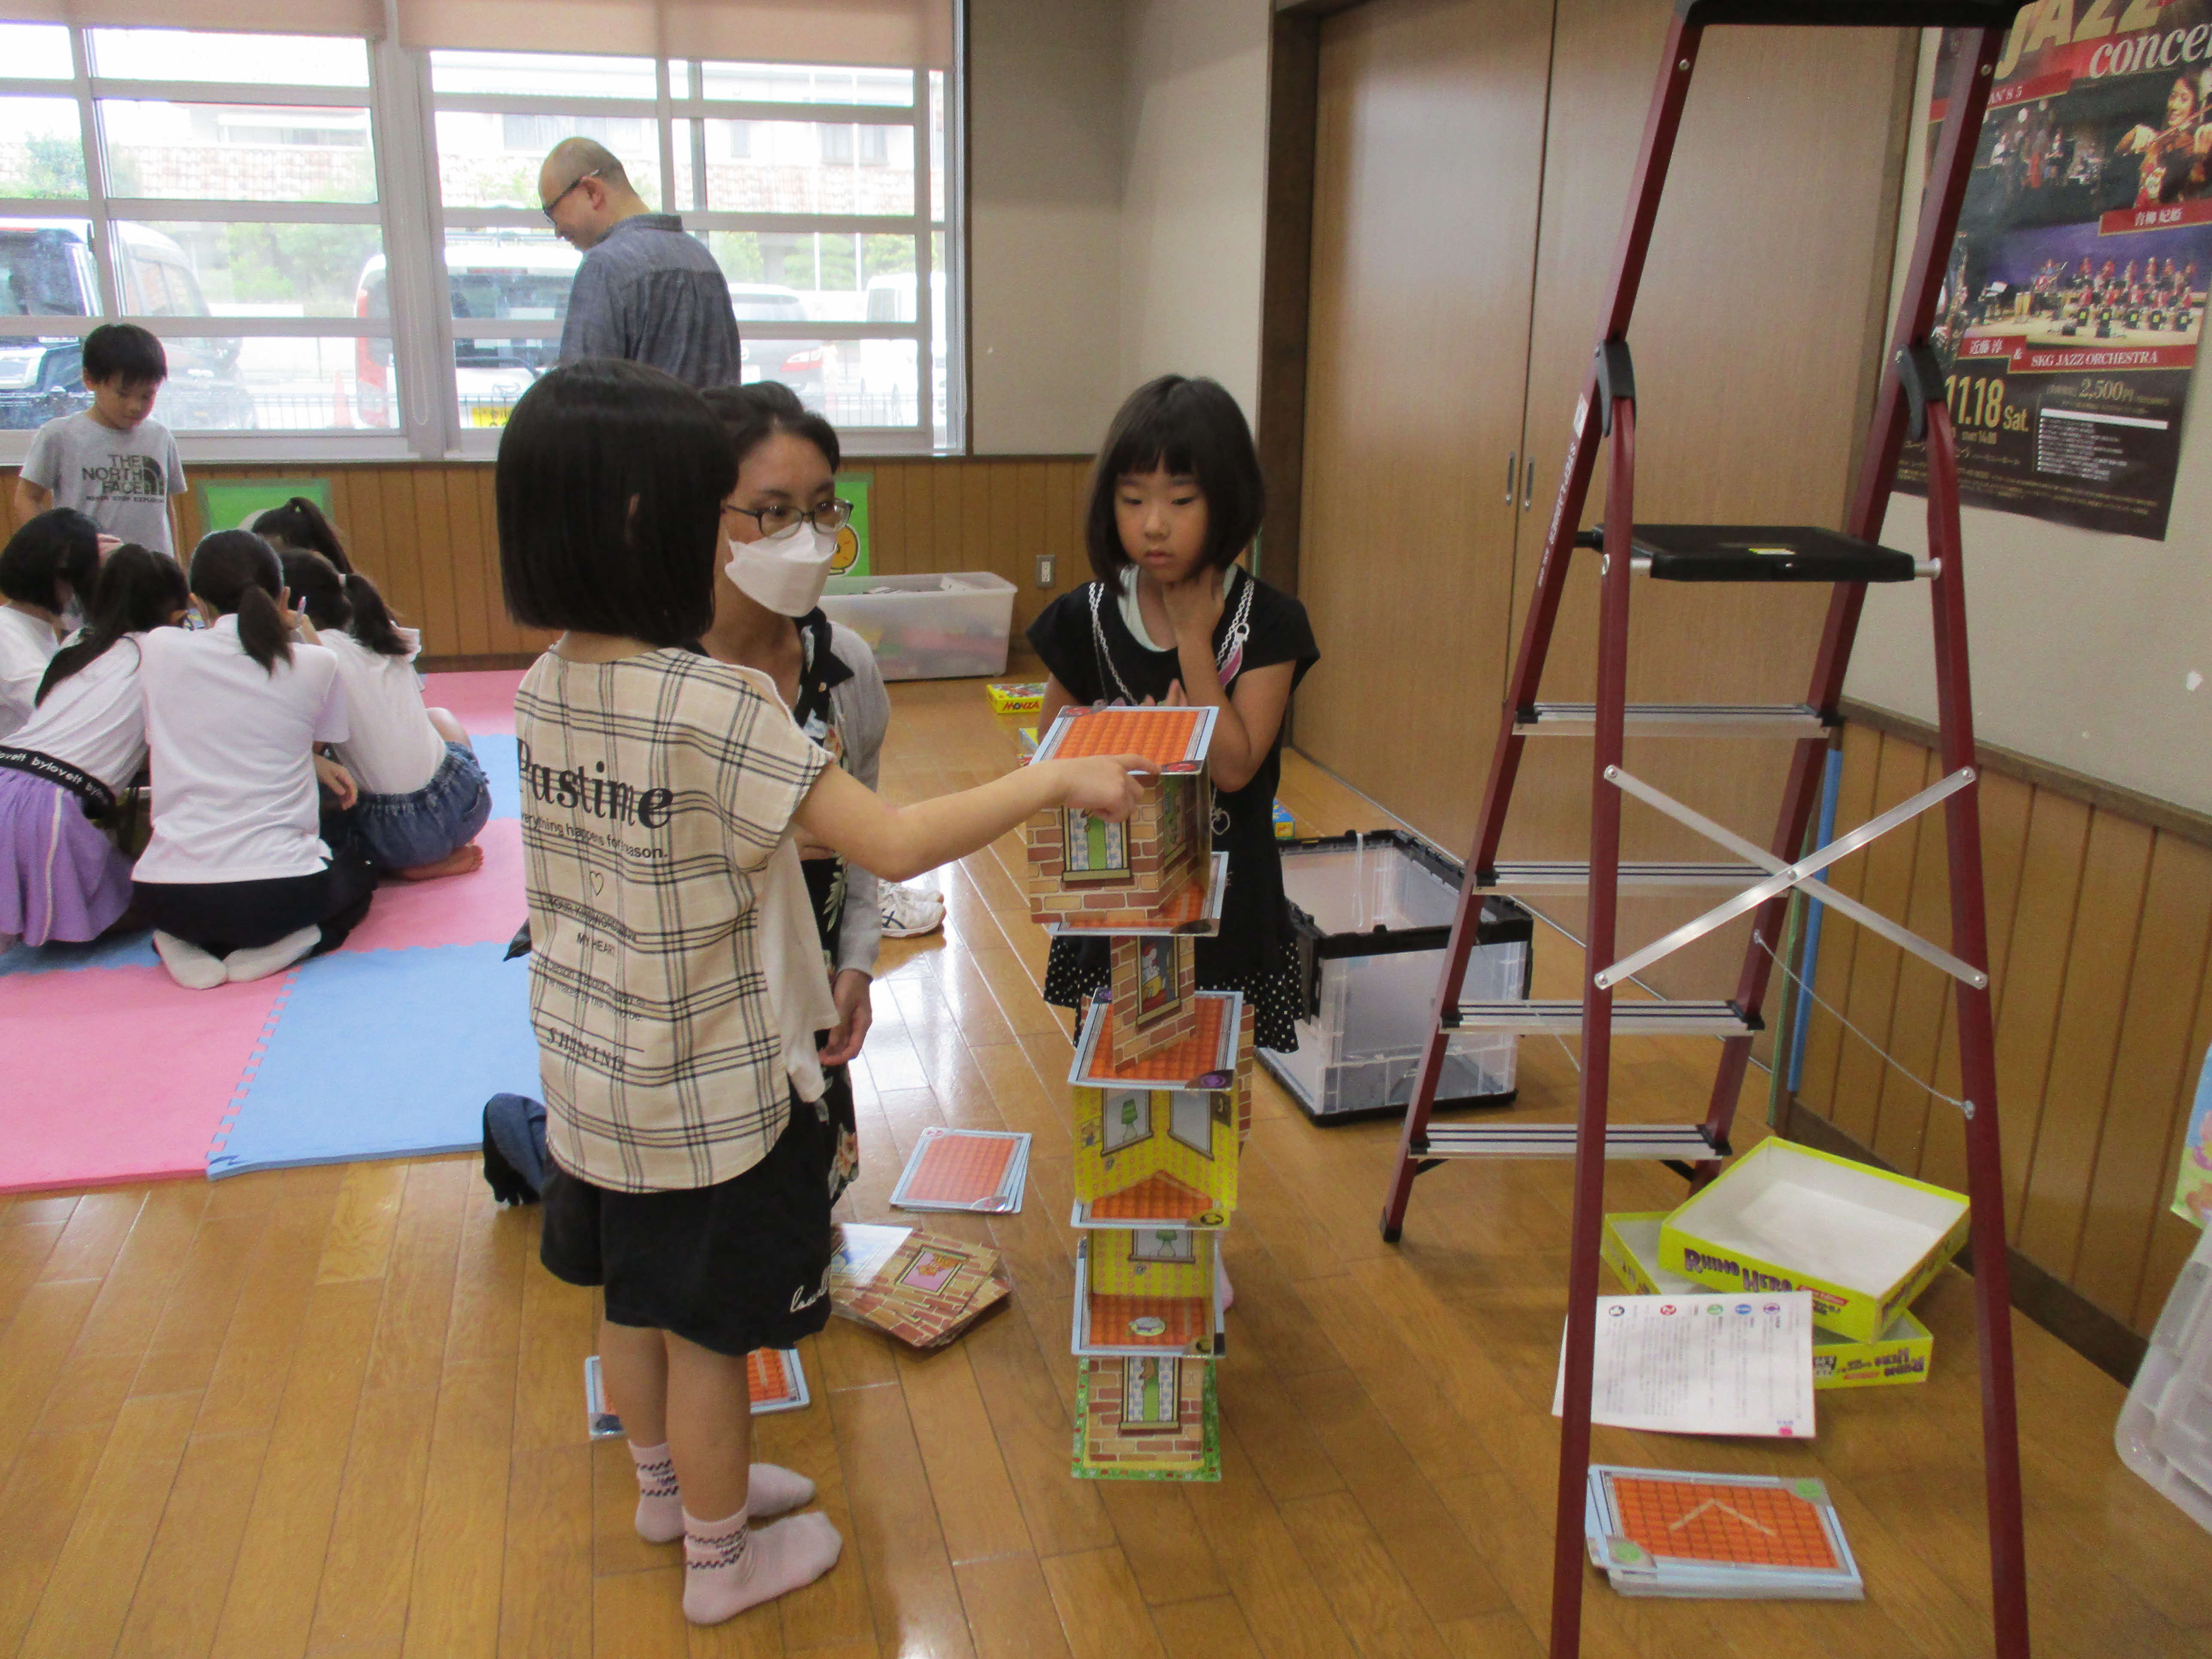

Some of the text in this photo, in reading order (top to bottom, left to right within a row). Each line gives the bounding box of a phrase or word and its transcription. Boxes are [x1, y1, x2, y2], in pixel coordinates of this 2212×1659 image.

[1994, 0, 2162, 79] JAZZ
[2013, 347, 2158, 367] & SKG JAZZ ORCHESTRA
[1944, 374, 2005, 428] 11.18
[107, 454, 140, 468] THE
[82, 467, 144, 480] NORTH
[102, 480, 143, 494] FACE
[1002, 700, 1040, 711] MONZA
[1684, 1247, 1740, 1276] RHINO
